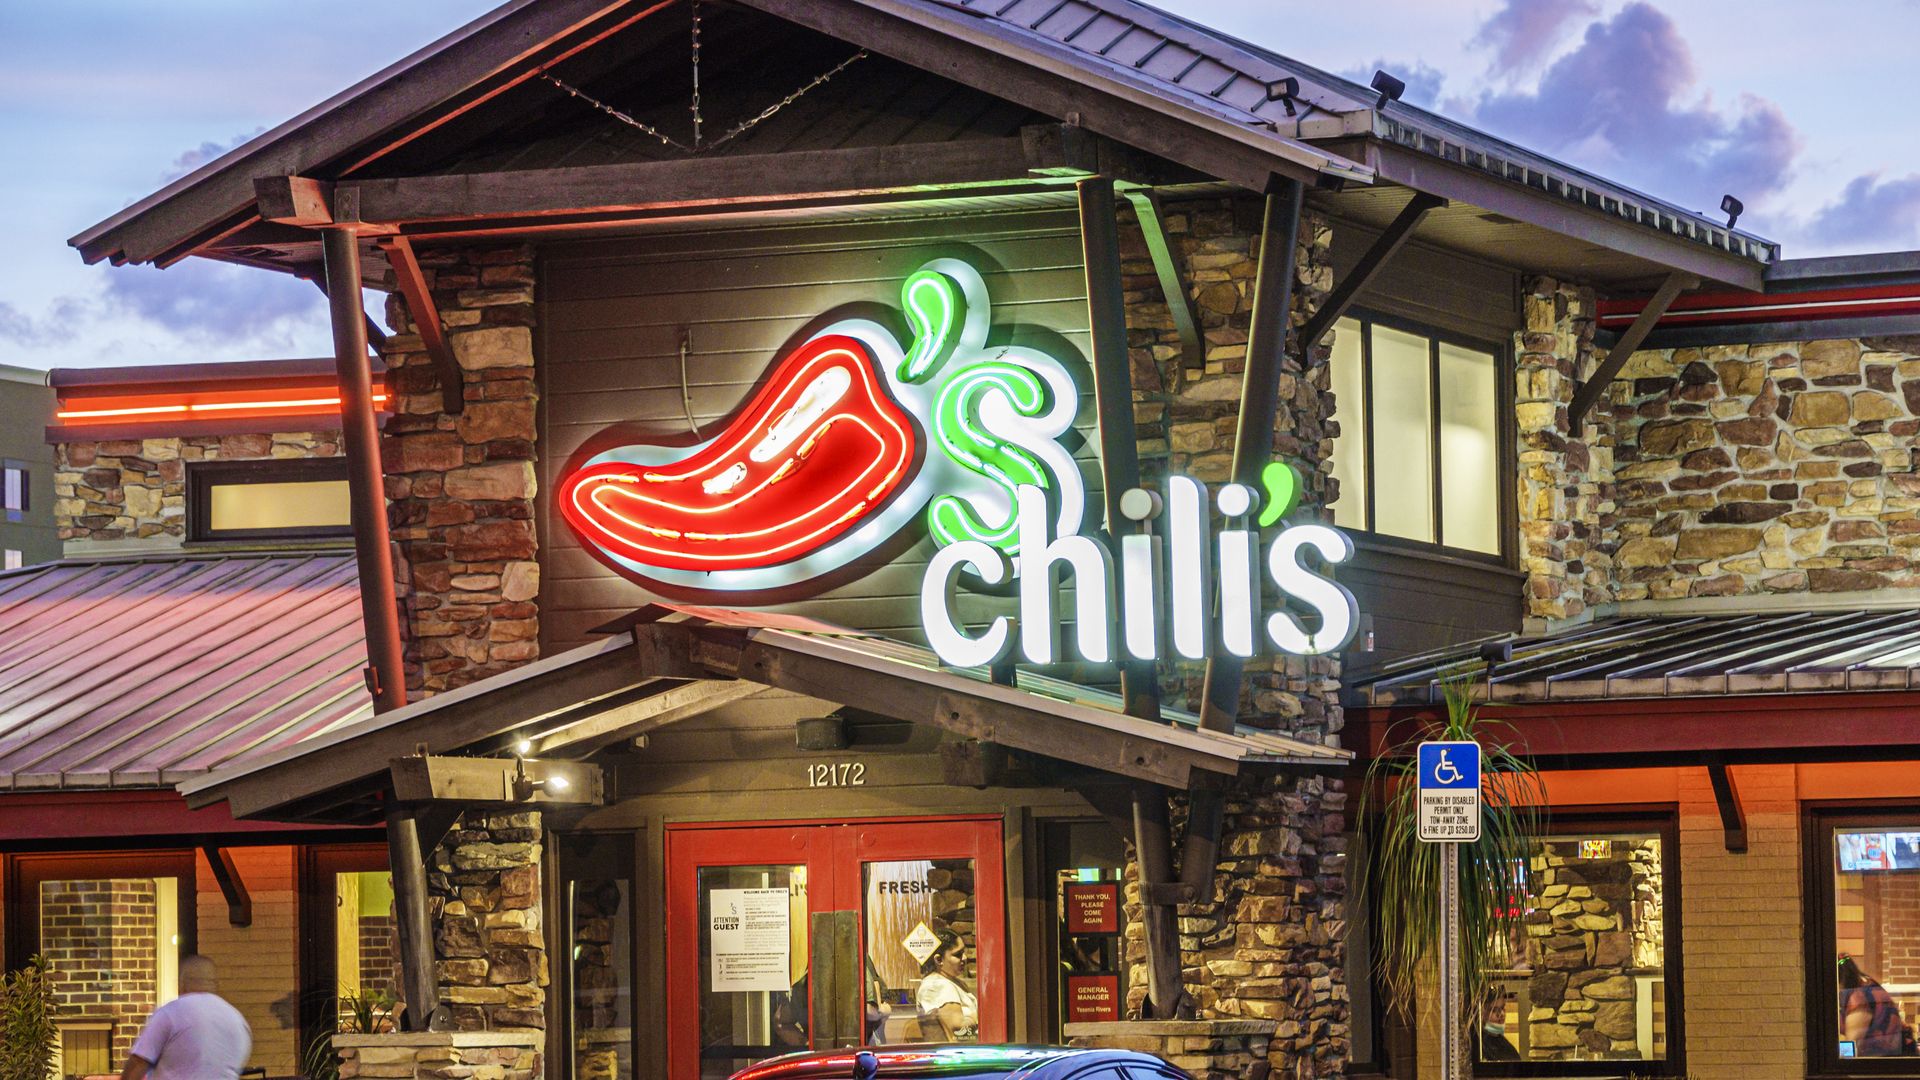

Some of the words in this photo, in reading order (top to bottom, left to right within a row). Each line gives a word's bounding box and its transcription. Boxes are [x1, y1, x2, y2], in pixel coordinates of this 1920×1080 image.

[920, 461, 1357, 668] chili's
[807, 762, 866, 787] 12172
[1423, 797, 1443, 805] PARKING
[1444, 796, 1451, 805] BY
[1452, 796, 1475, 805] DISABLED
[1434, 806, 1452, 815] PERMIT
[1452, 806, 1464, 815] ONLY
[1456, 815, 1469, 824] ZONE
[1428, 825, 1439, 834] FINE
[1440, 825, 1447, 834] UP
[1447, 825, 1454, 835] TO
[1455, 825, 1475, 834] $250.00
[879, 881, 932, 894] FRESH
[1077, 993, 1109, 1001] MANAGER
